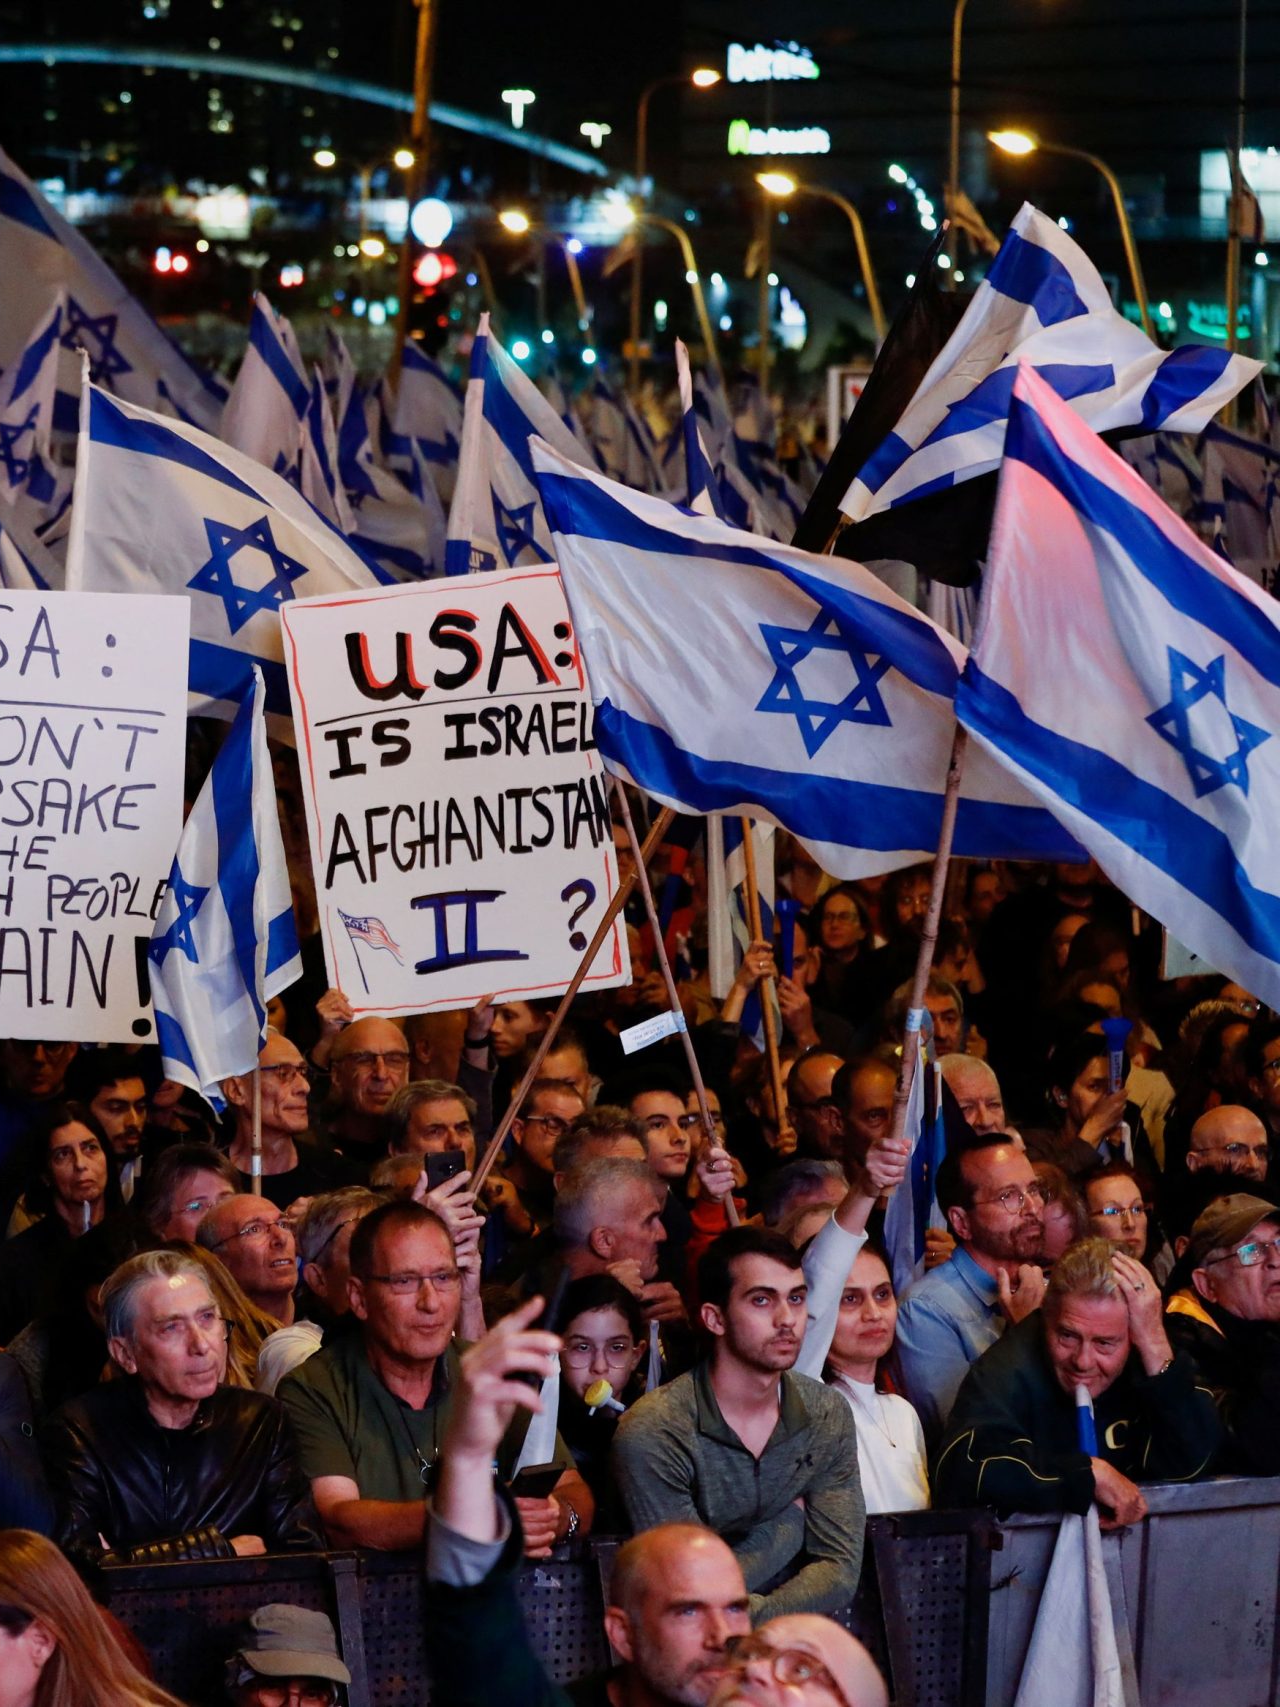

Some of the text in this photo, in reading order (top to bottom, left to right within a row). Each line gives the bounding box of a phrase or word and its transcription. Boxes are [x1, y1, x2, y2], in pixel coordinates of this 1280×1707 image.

[344, 602, 576, 701] USA:
[324, 701, 596, 779] IS ISRAEL
[325, 772, 613, 890] AFGHANISTAN
[46, 872, 169, 921] PEOPLE
[411, 888, 530, 975] II
